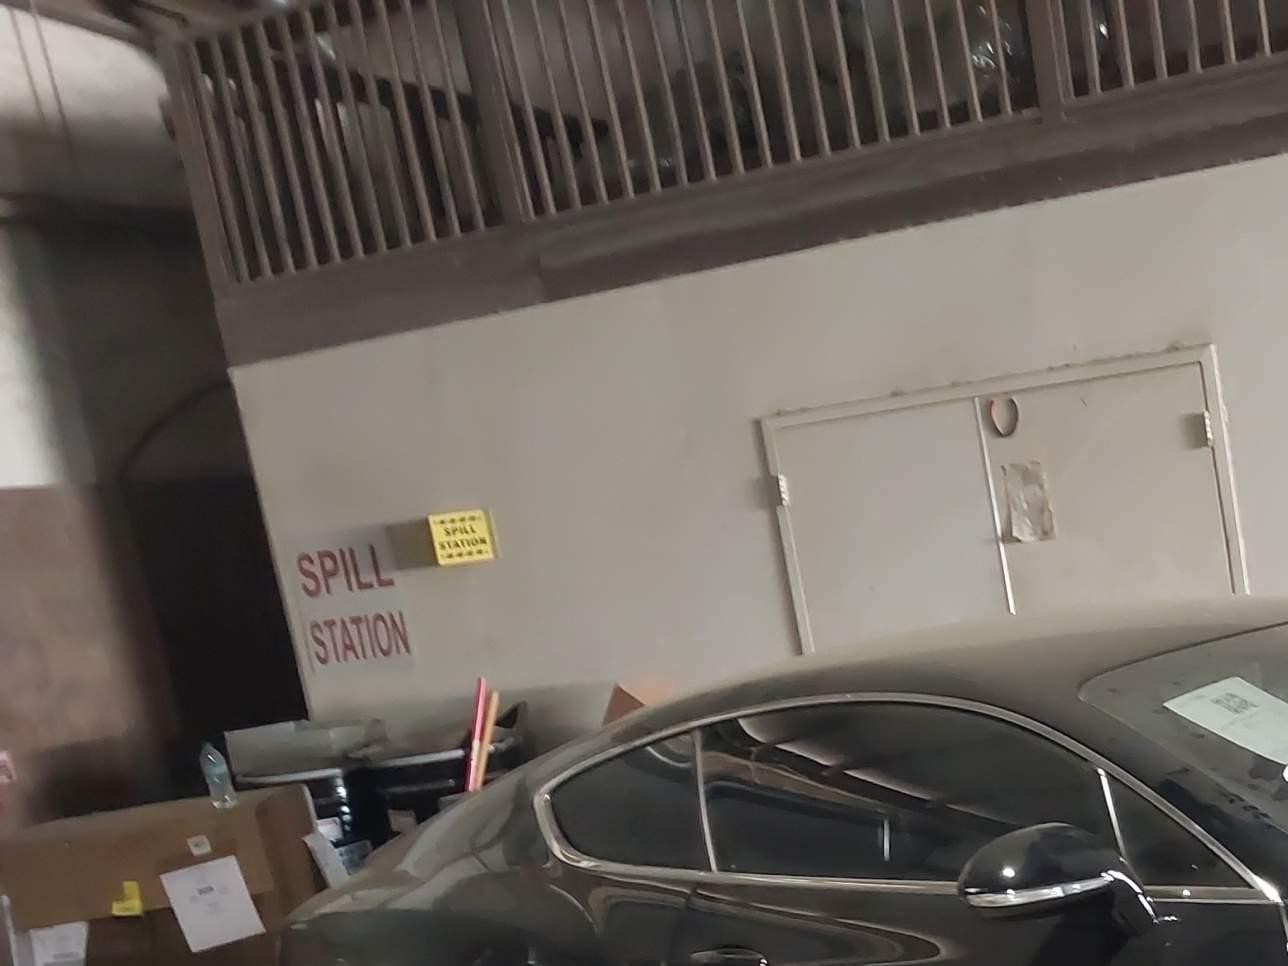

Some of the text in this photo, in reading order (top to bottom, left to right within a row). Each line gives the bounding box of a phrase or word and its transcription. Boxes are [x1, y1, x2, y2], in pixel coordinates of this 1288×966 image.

[438, 536, 487, 550] STATION
[444, 524, 477, 537] SPILL
[297, 544, 395, 598] SPILL
[310, 609, 413, 666] STATION
